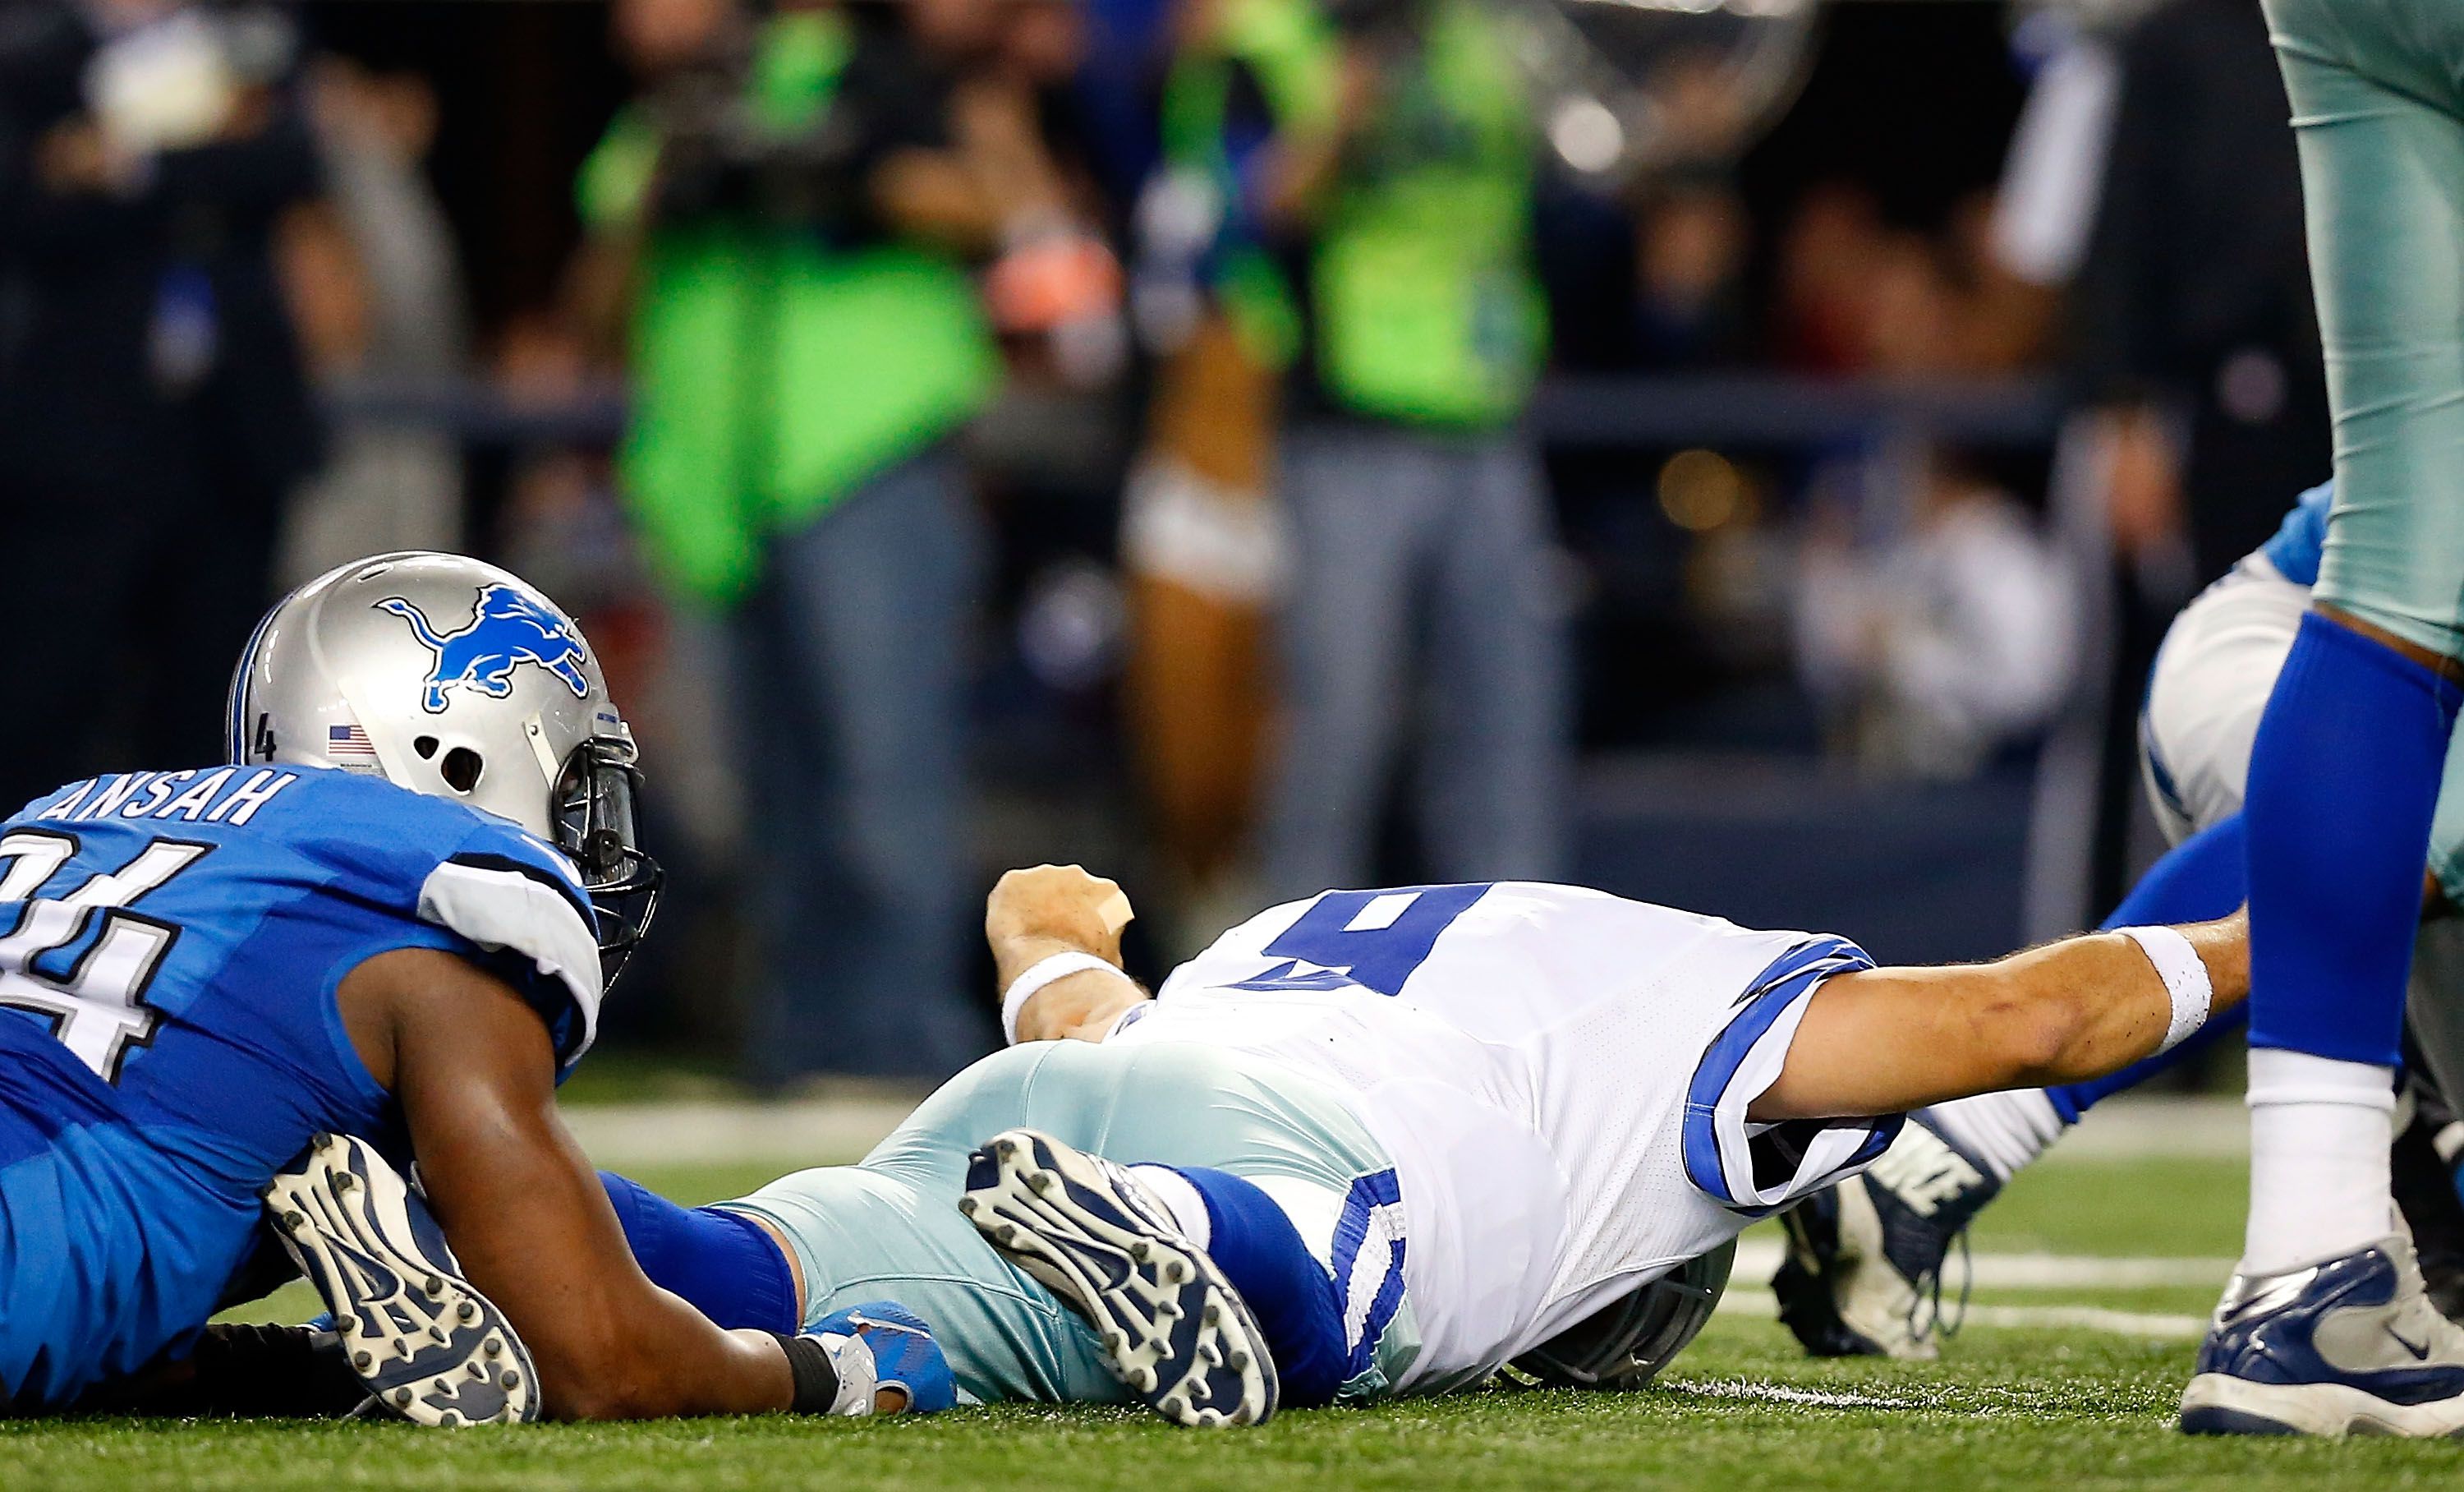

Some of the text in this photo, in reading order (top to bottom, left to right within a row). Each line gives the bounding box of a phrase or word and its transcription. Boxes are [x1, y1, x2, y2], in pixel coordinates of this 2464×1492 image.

[254, 711, 277, 762] 4
[37, 766, 299, 827] ANSAH
[1868, 1117, 1984, 1218] NIKE
